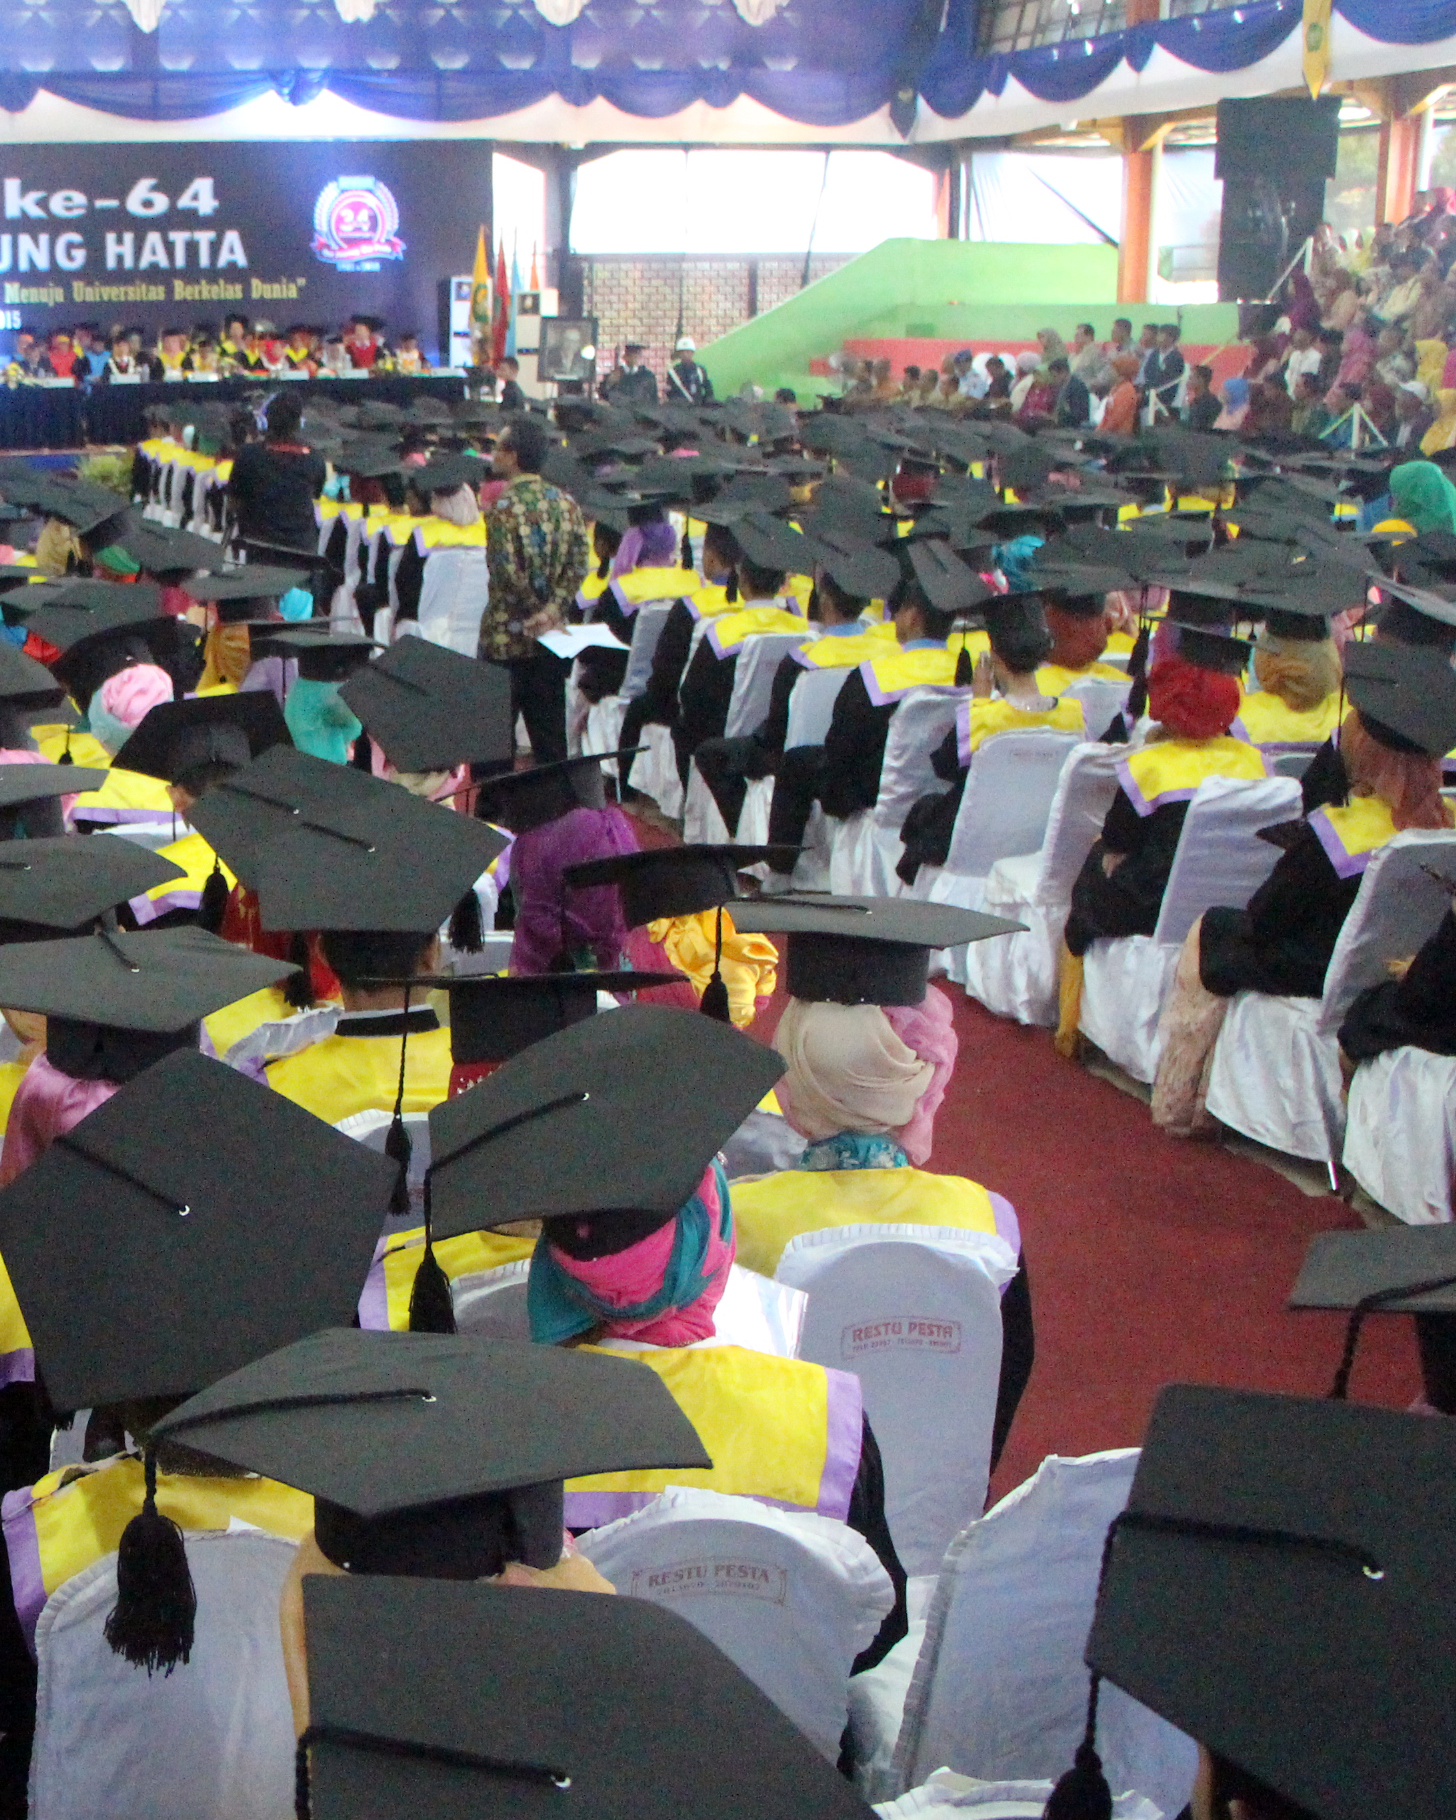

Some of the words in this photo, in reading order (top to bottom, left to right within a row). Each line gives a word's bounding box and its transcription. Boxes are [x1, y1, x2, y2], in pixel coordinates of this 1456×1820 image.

[3, 176, 220, 219] ke-64
[105, 229, 248, 271] HATTA
[4, 281, 64, 306] Menuju
[72, 280, 165, 302] Universitas
[173, 278, 243, 300] Berkelas
[852, 1322, 903, 1342] RESTU
[908, 1322, 953, 1339] PESTA
[649, 1566, 708, 1587] RESTU
[714, 1564, 770, 1583] PESTA
